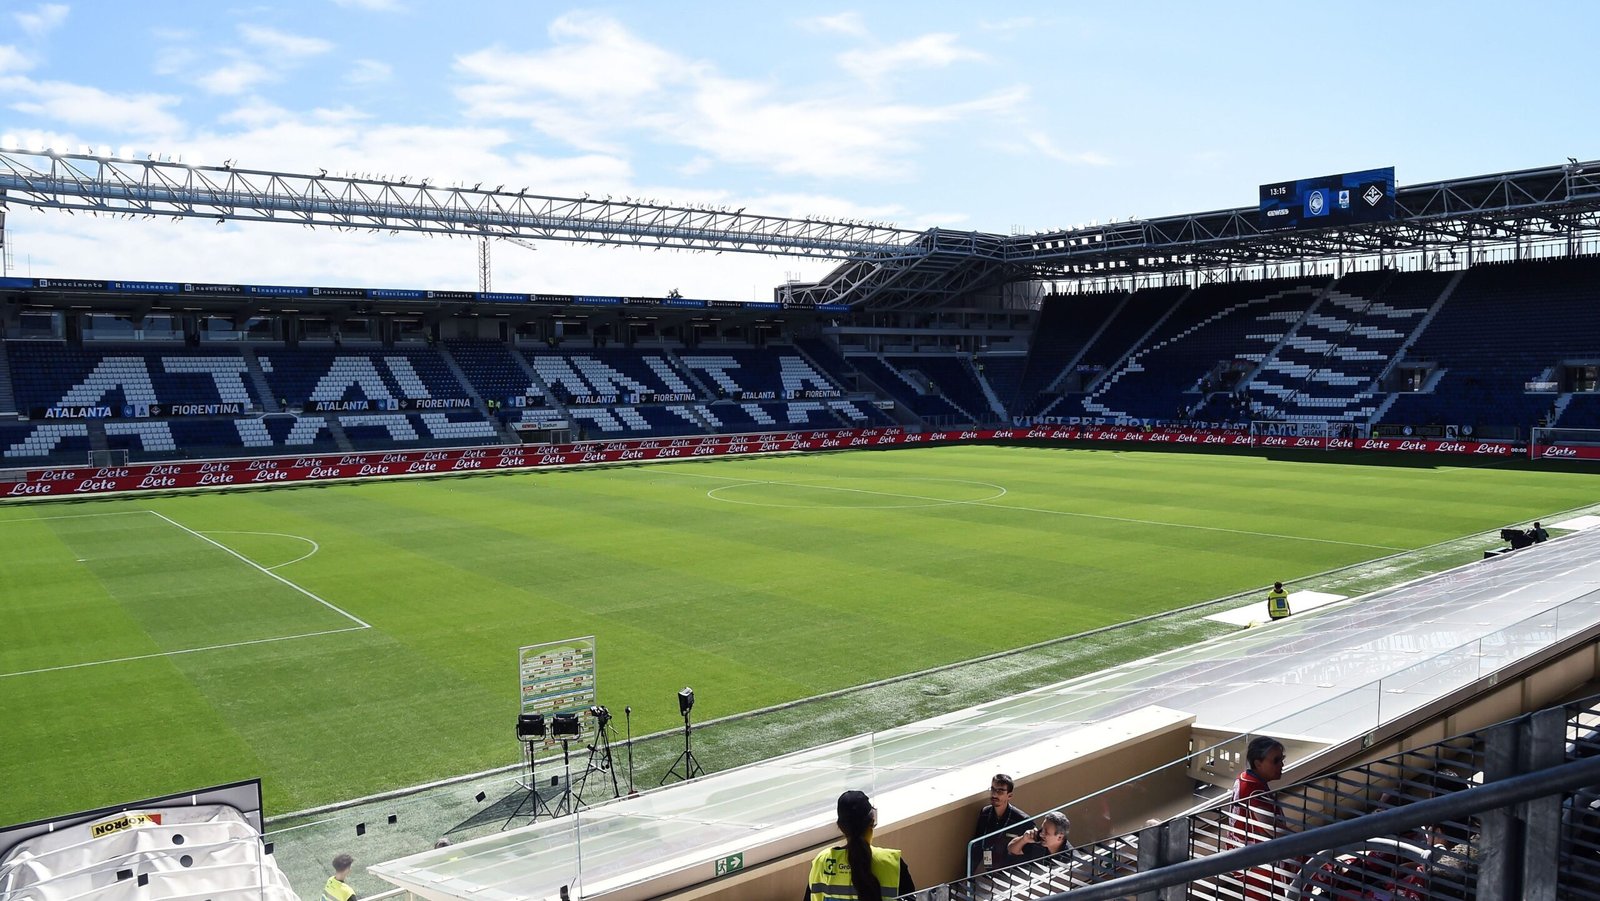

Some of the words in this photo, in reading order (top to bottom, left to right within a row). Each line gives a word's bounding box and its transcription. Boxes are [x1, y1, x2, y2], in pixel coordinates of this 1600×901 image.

[1270, 187, 1286, 196] 13:15
[40, 279, 103, 288] Rinascimento
[115, 281, 173, 290] Rinascimento
[576, 394, 617, 404] ATALANTA
[653, 393, 696, 402] FIORENTINA
[742, 391, 776, 400] ATALANTA
[805, 390, 841, 399] FIORENTINA
[316, 400, 369, 411] ATALANTA
[417, 399, 471, 409] FIORENTINA
[45, 407, 113, 419] ATALANTA
[172, 404, 240, 415] FIORENTINA
[36, 471, 75, 481] Lete
[92, 468, 129, 479] Lete
[145, 465, 181, 476] Lete
[196, 463, 230, 474] Lete
[246, 460, 278, 471] Lete
[292, 458, 322, 469] Lete
[337, 456, 367, 466] Lete
[380, 454, 407, 464] Lete
[420, 452, 448, 461] Lete
[460, 450, 486, 459] Lete
[498, 448, 524, 458] Lete
[535, 446, 560, 456] Lete
[606, 443, 628, 451] Lete
[638, 441, 660, 449] Lete
[670, 439, 690, 447] Lete
[700, 437, 720, 446] Lete
[728, 436, 748, 444] Lete
[758, 434, 776, 442] Lete
[785, 433, 803, 441] Lete
[811, 431, 829, 439] Lete
[836, 430, 853, 438] Lete
[861, 429, 878, 437] Lete
[884, 428, 900, 436] Lete
[1542, 445, 1577, 458] Lete
[7, 483, 51, 495] Lete
[74, 480, 116, 492] Lete
[136, 476, 176, 488] Lete
[196, 473, 234, 485] Lete
[252, 470, 288, 481] Lete
[306, 467, 340, 478] Lete
[356, 465, 390, 475] Lete
[406, 462, 436, 472] Lete
[452, 459, 482, 470] Lete
[497, 457, 525, 467] Lete
[539, 454, 566, 464] Lete
[580, 452, 607, 462] Lete
[619, 450, 644, 460] Lete
[656, 448, 680, 458] Lete
[692, 446, 715, 455] Lete
[727, 444, 749, 453] Lete
[759, 443, 780, 451] Lete
[790, 441, 811, 449] Lete
[820, 439, 840, 447] Lete
[849, 437, 869, 446] Lete
[877, 436, 896, 444] Lete
[904, 434, 922, 442] Lete
[930, 432, 947, 441] Lete
[959, 431, 978, 440] Lete
[992, 430, 1013, 438] Lete
[1026, 430, 1047, 438] Lete
[1051, 430, 1070, 438] Lete
[1098, 431, 1118, 440] Lete
[1123, 432, 1144, 440] Lete
[1148, 433, 1170, 441] Lete
[1175, 433, 1198, 442] Lete
[1203, 434, 1226, 443] Lete
[1262, 437, 1287, 446] Lete
[1294, 438, 1320, 447] Lete
[1327, 438, 1354, 448] Lete
[1362, 440, 1390, 449] Lete
[1398, 441, 1427, 451] Lete
[1435, 442, 1466, 452] Lete
[1474, 444, 1506, 454] Lete
[95, 817, 145, 836] KOPRON
